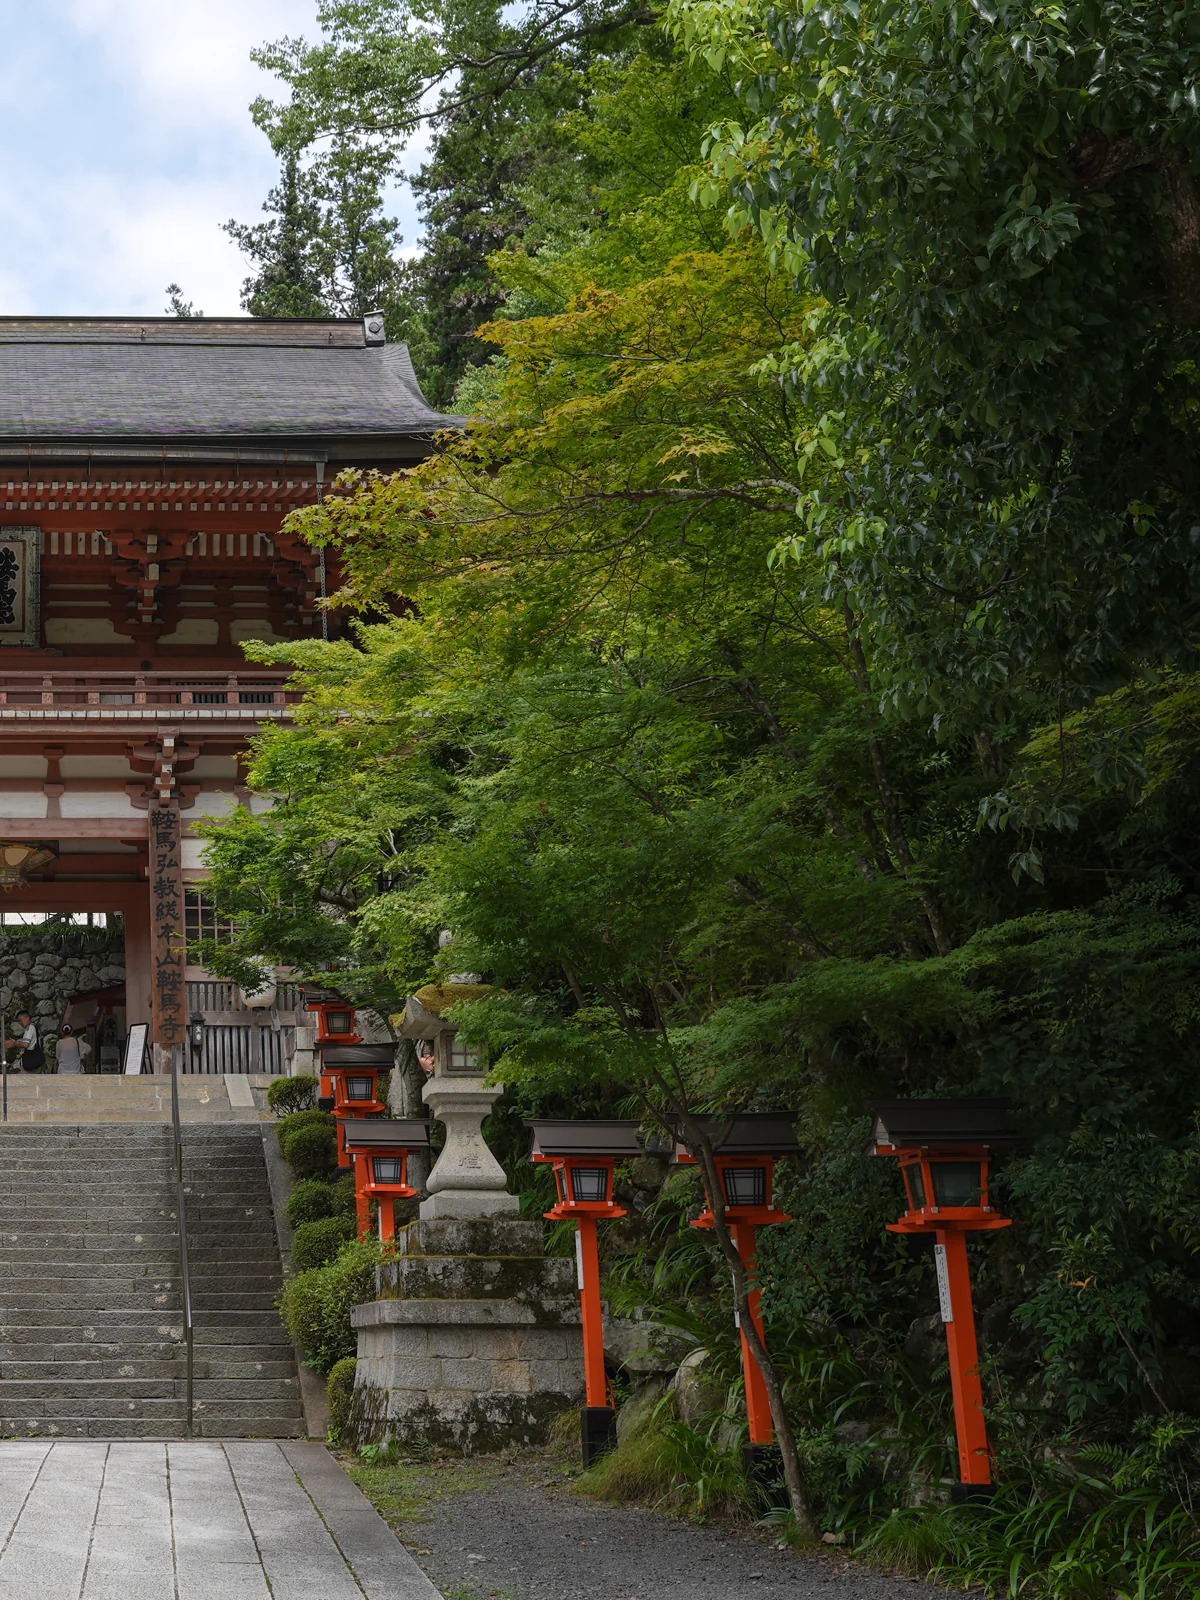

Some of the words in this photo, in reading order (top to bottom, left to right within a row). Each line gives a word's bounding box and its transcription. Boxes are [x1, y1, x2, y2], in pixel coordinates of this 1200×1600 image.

[151, 810, 184, 1041] 鞍馬弘教総本山鞍馬寺
